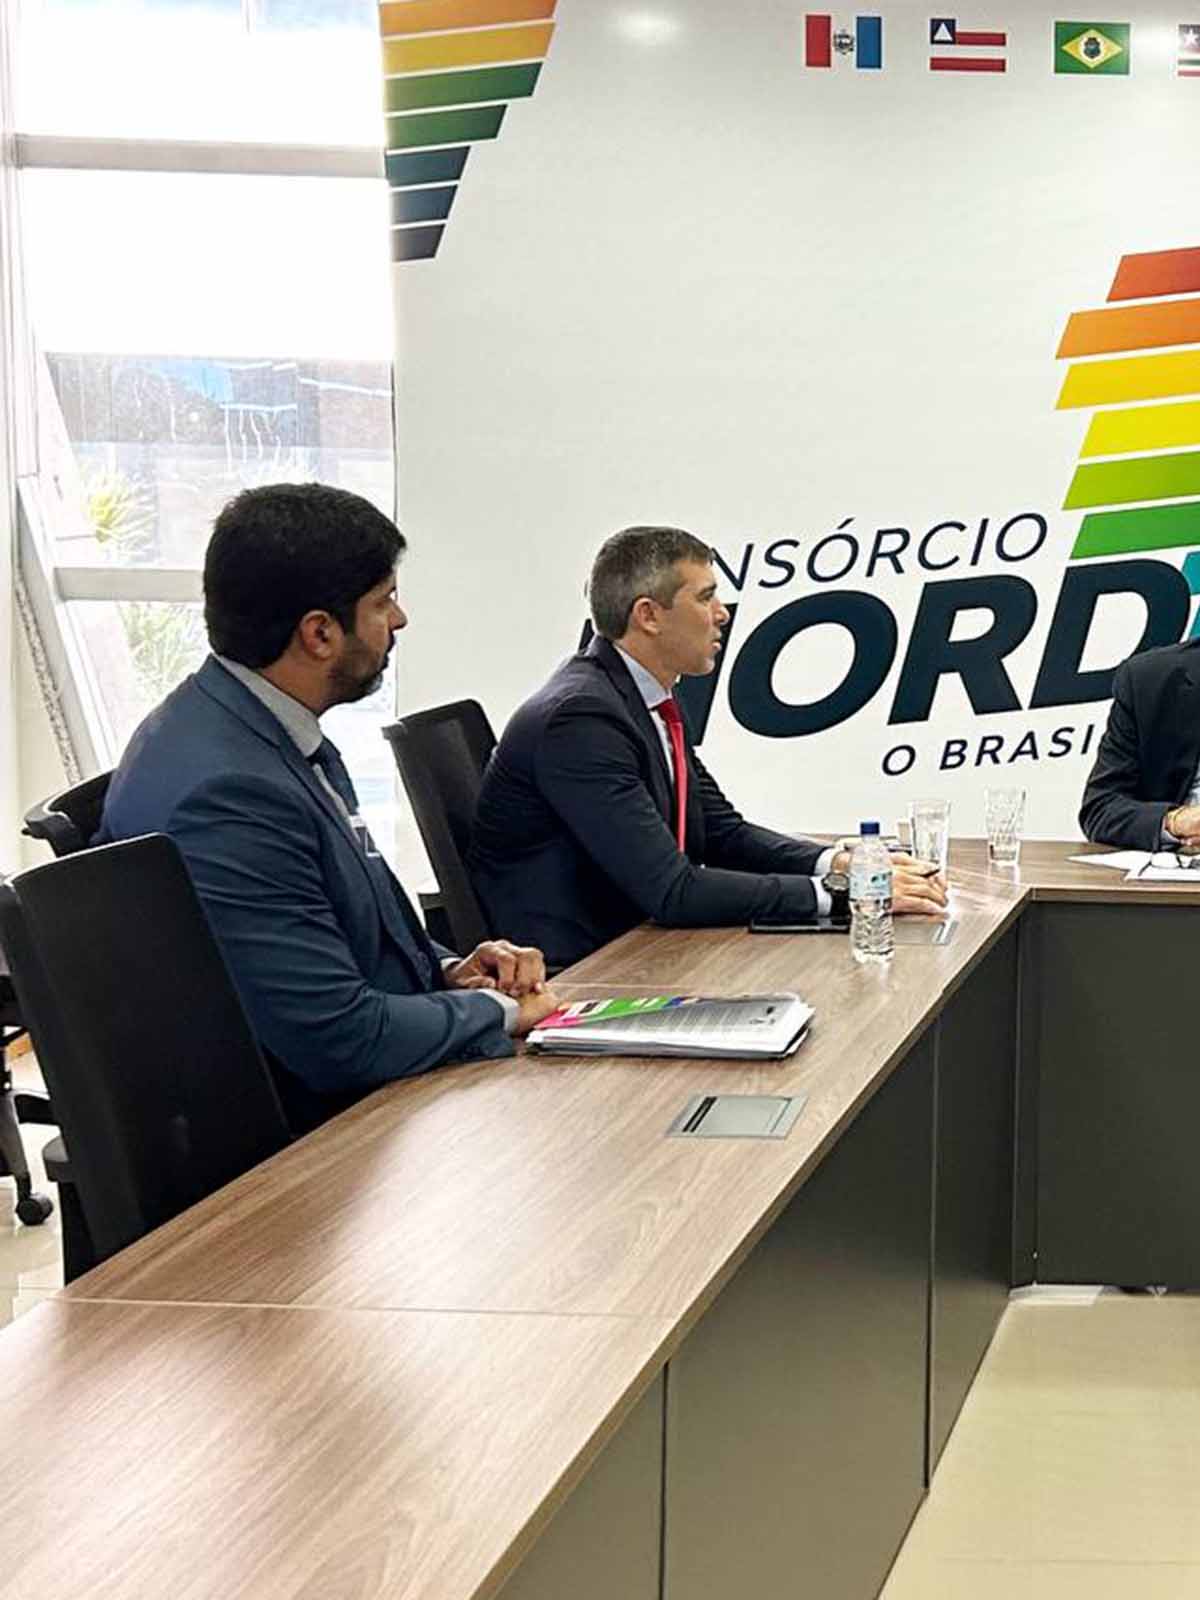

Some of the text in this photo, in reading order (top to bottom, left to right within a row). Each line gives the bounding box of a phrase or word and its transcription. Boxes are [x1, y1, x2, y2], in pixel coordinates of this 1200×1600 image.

[585, 516, 1048, 597] NSÓRCIO
[882, 744, 916, 776] O
[939, 724, 1095, 771] BRASI
